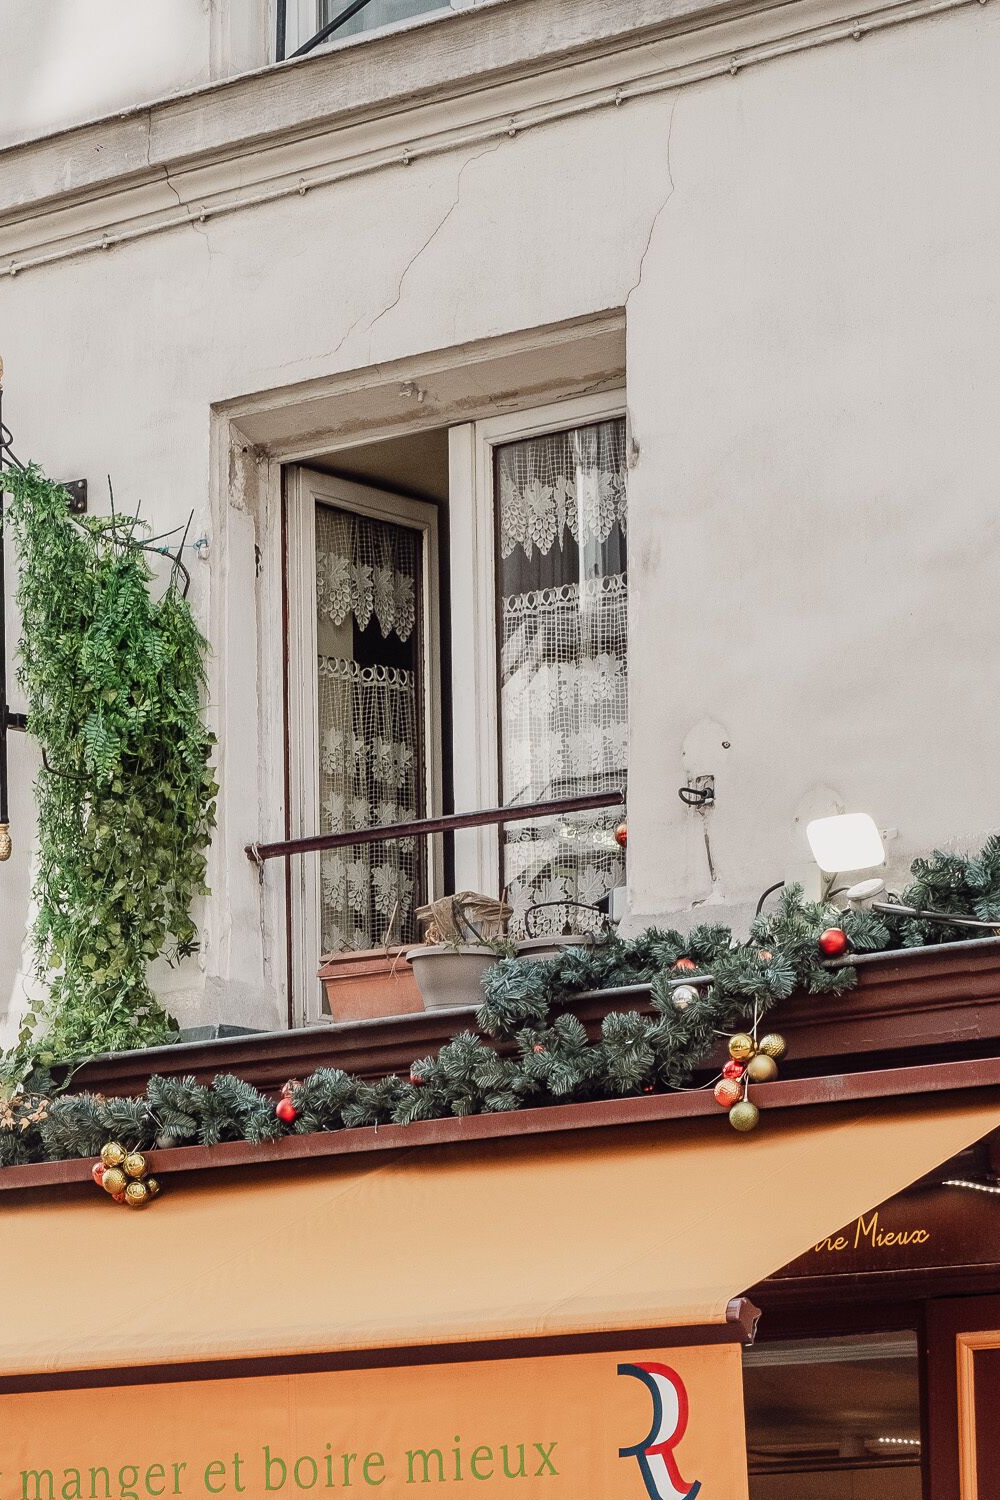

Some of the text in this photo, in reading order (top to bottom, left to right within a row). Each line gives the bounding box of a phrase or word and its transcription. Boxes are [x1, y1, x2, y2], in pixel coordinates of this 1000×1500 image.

[854, 1211, 930, 1248] Mieux
[204, 1452, 246, 1494] et
[262, 1443, 386, 1492] boire
[404, 1435, 560, 1484] mieux
